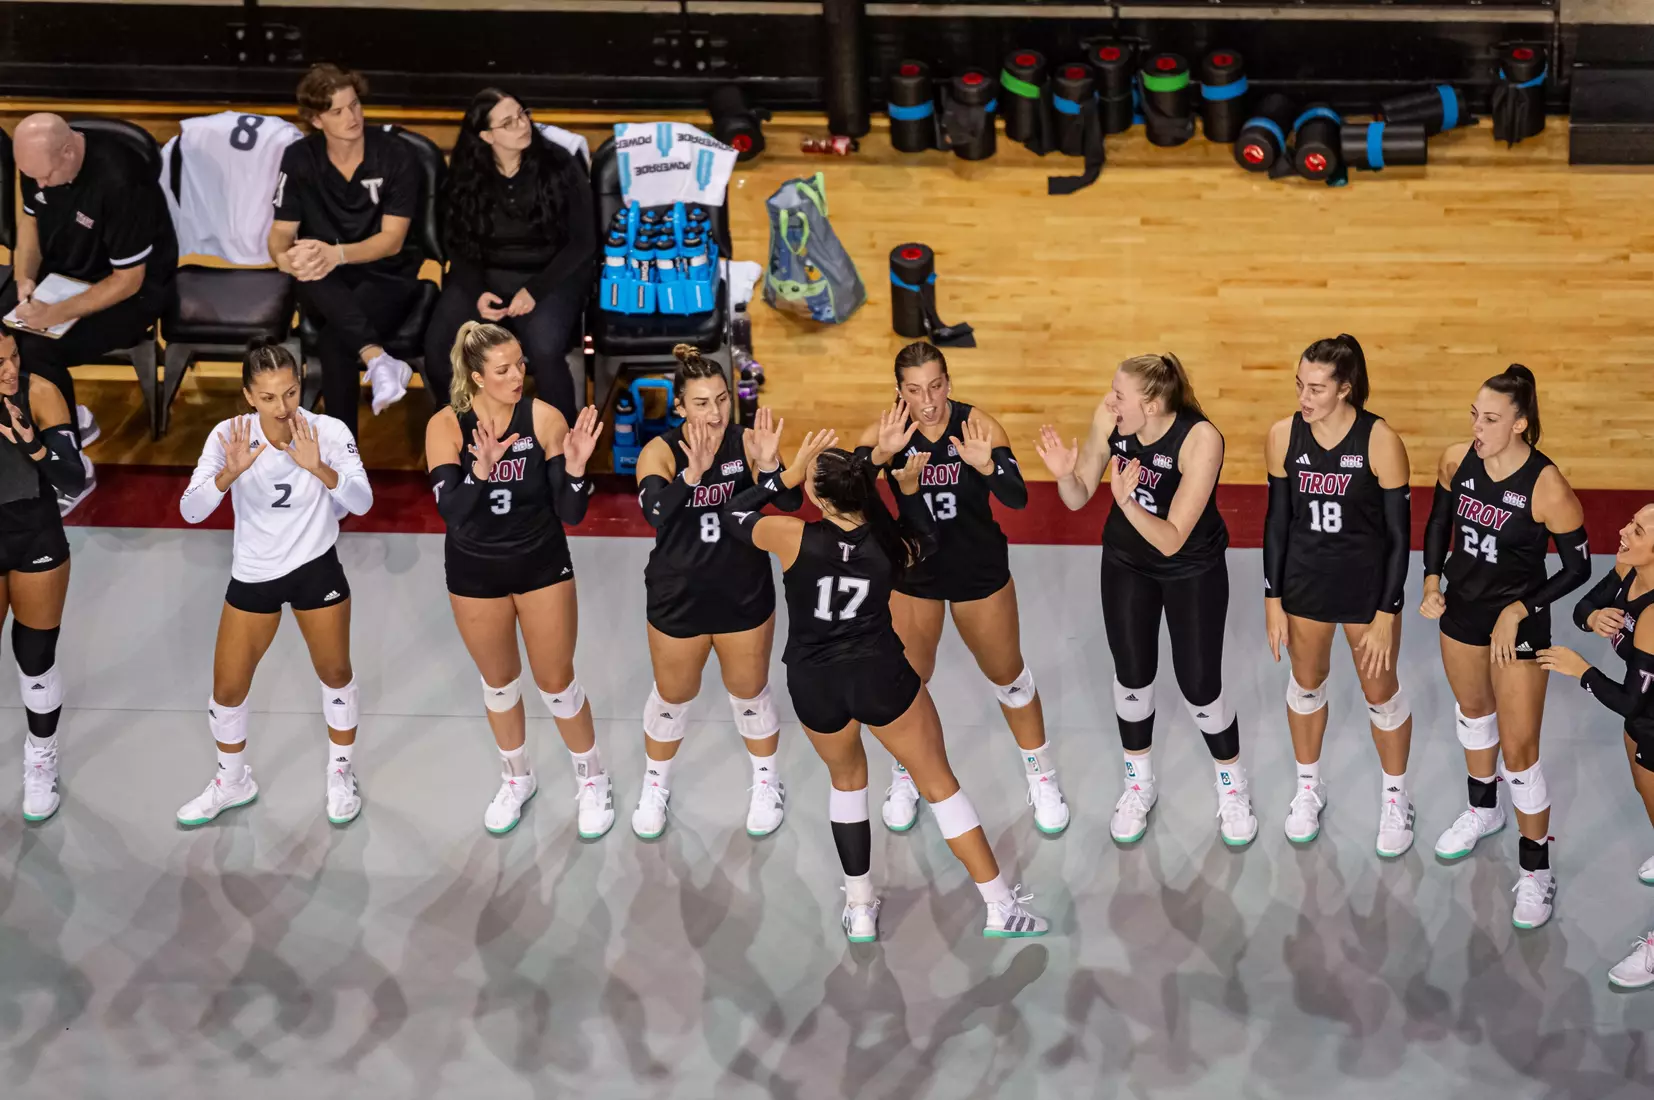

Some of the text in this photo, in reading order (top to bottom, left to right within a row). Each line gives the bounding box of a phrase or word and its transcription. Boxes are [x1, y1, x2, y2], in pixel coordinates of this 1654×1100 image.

[230, 115, 264, 151] 8
[633, 161, 692, 176] POWERADE
[360, 177, 384, 205] T
[512, 437, 534, 452] SBC
[472, 457, 527, 483] ROY
[721, 460, 744, 476] SBC
[921, 461, 961, 485] ROY
[1116, 453, 1162, 489] TOY
[1153, 453, 1173, 469] SBC
[1340, 455, 1364, 468] SBC
[685, 480, 735, 507] ROY
[1298, 470, 1352, 495] TROY
[271, 483, 292, 508] 2
[489, 489, 512, 514] 3
[1130, 488, 1158, 514] 2
[1502, 490, 1526, 508] SBC
[1308, 500, 1342, 533] 18
[1457, 493, 1512, 531] TROY
[700, 512, 721, 543] 8
[838, 541, 856, 562] T
[1460, 525, 1498, 564] 24
[814, 575, 870, 621] 17
